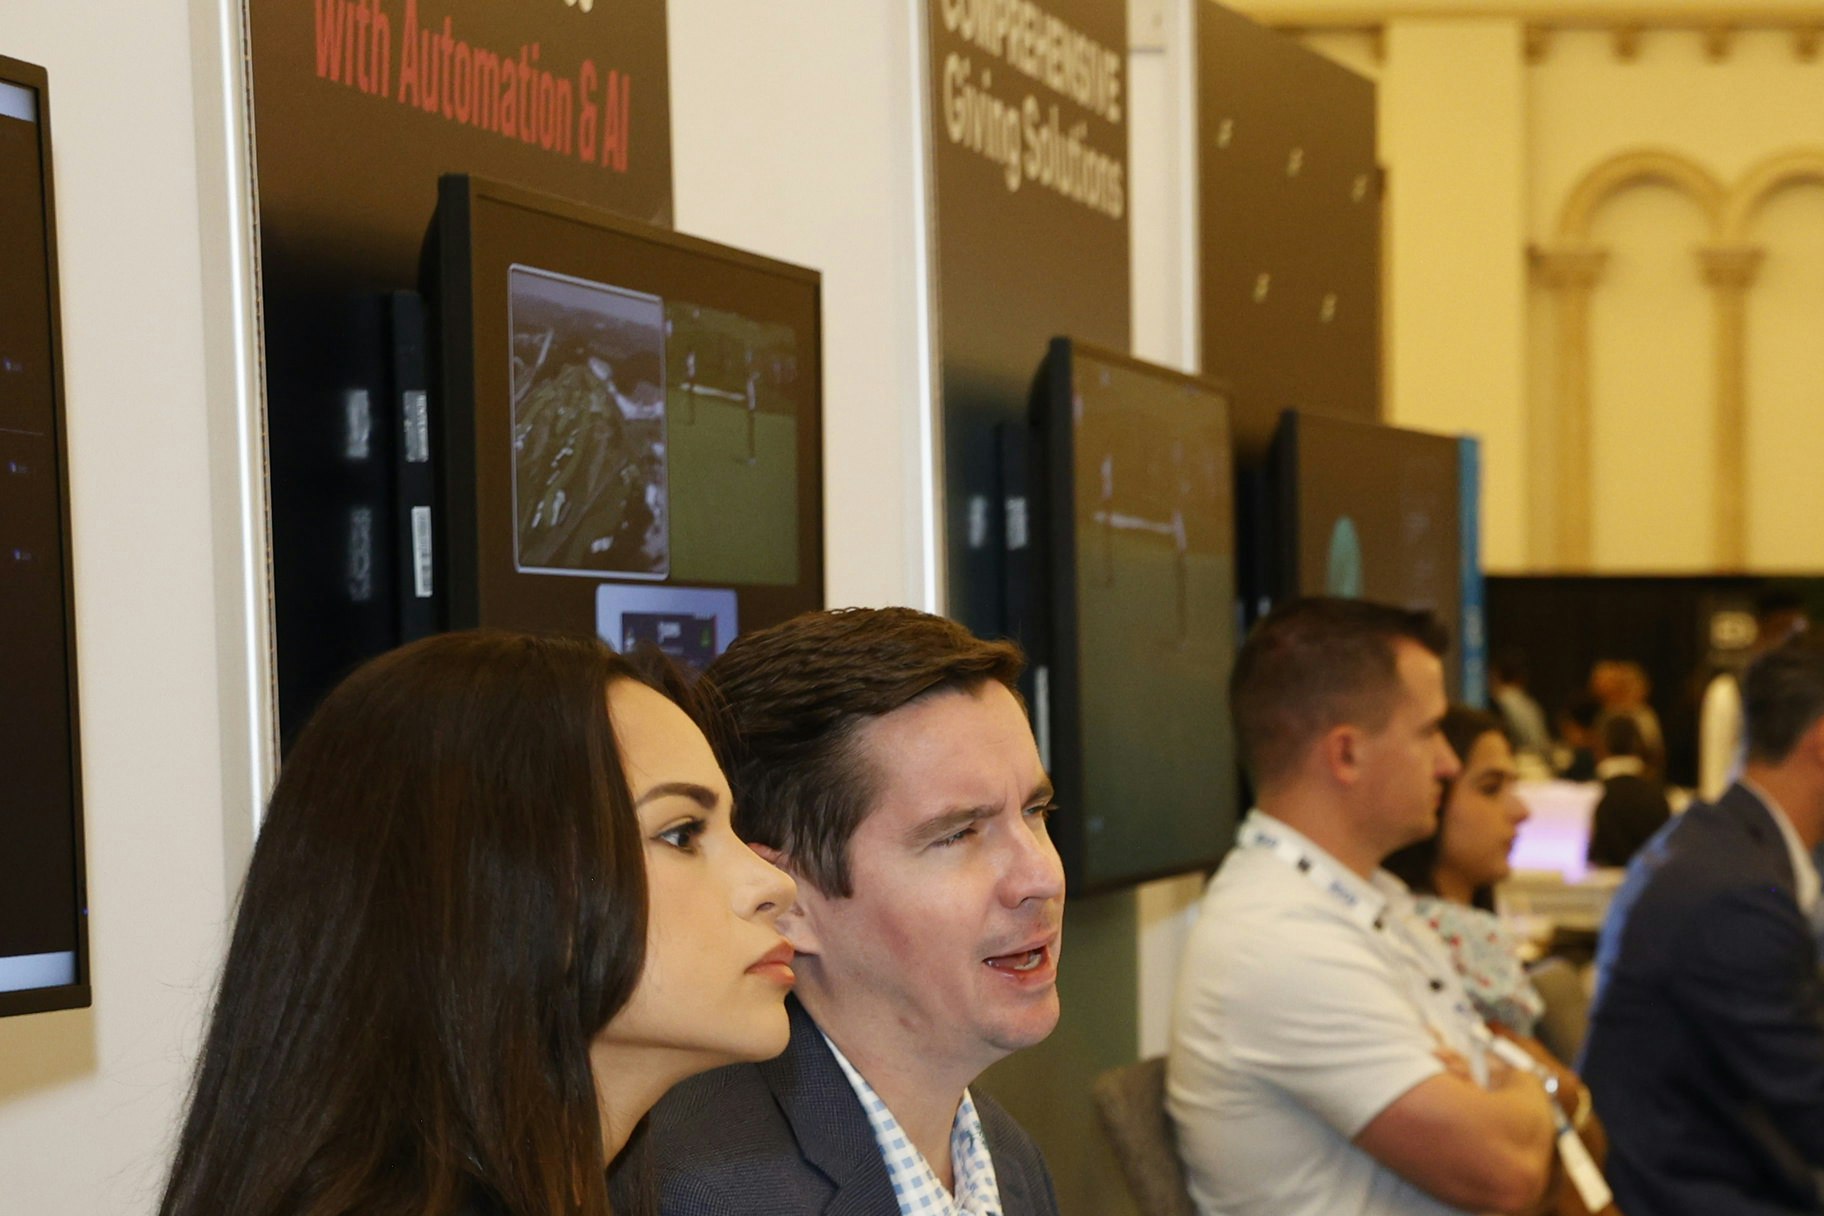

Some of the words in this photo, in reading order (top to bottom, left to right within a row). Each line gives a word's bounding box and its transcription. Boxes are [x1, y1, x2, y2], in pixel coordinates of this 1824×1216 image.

[315, 0, 390, 98] with
[397, 0, 574, 155] Automation
[577, 58, 598, 163] &
[602, 68, 630, 173] AI
[943, 53, 1021, 192] Giving
[1022, 95, 1123, 219] Solutions
